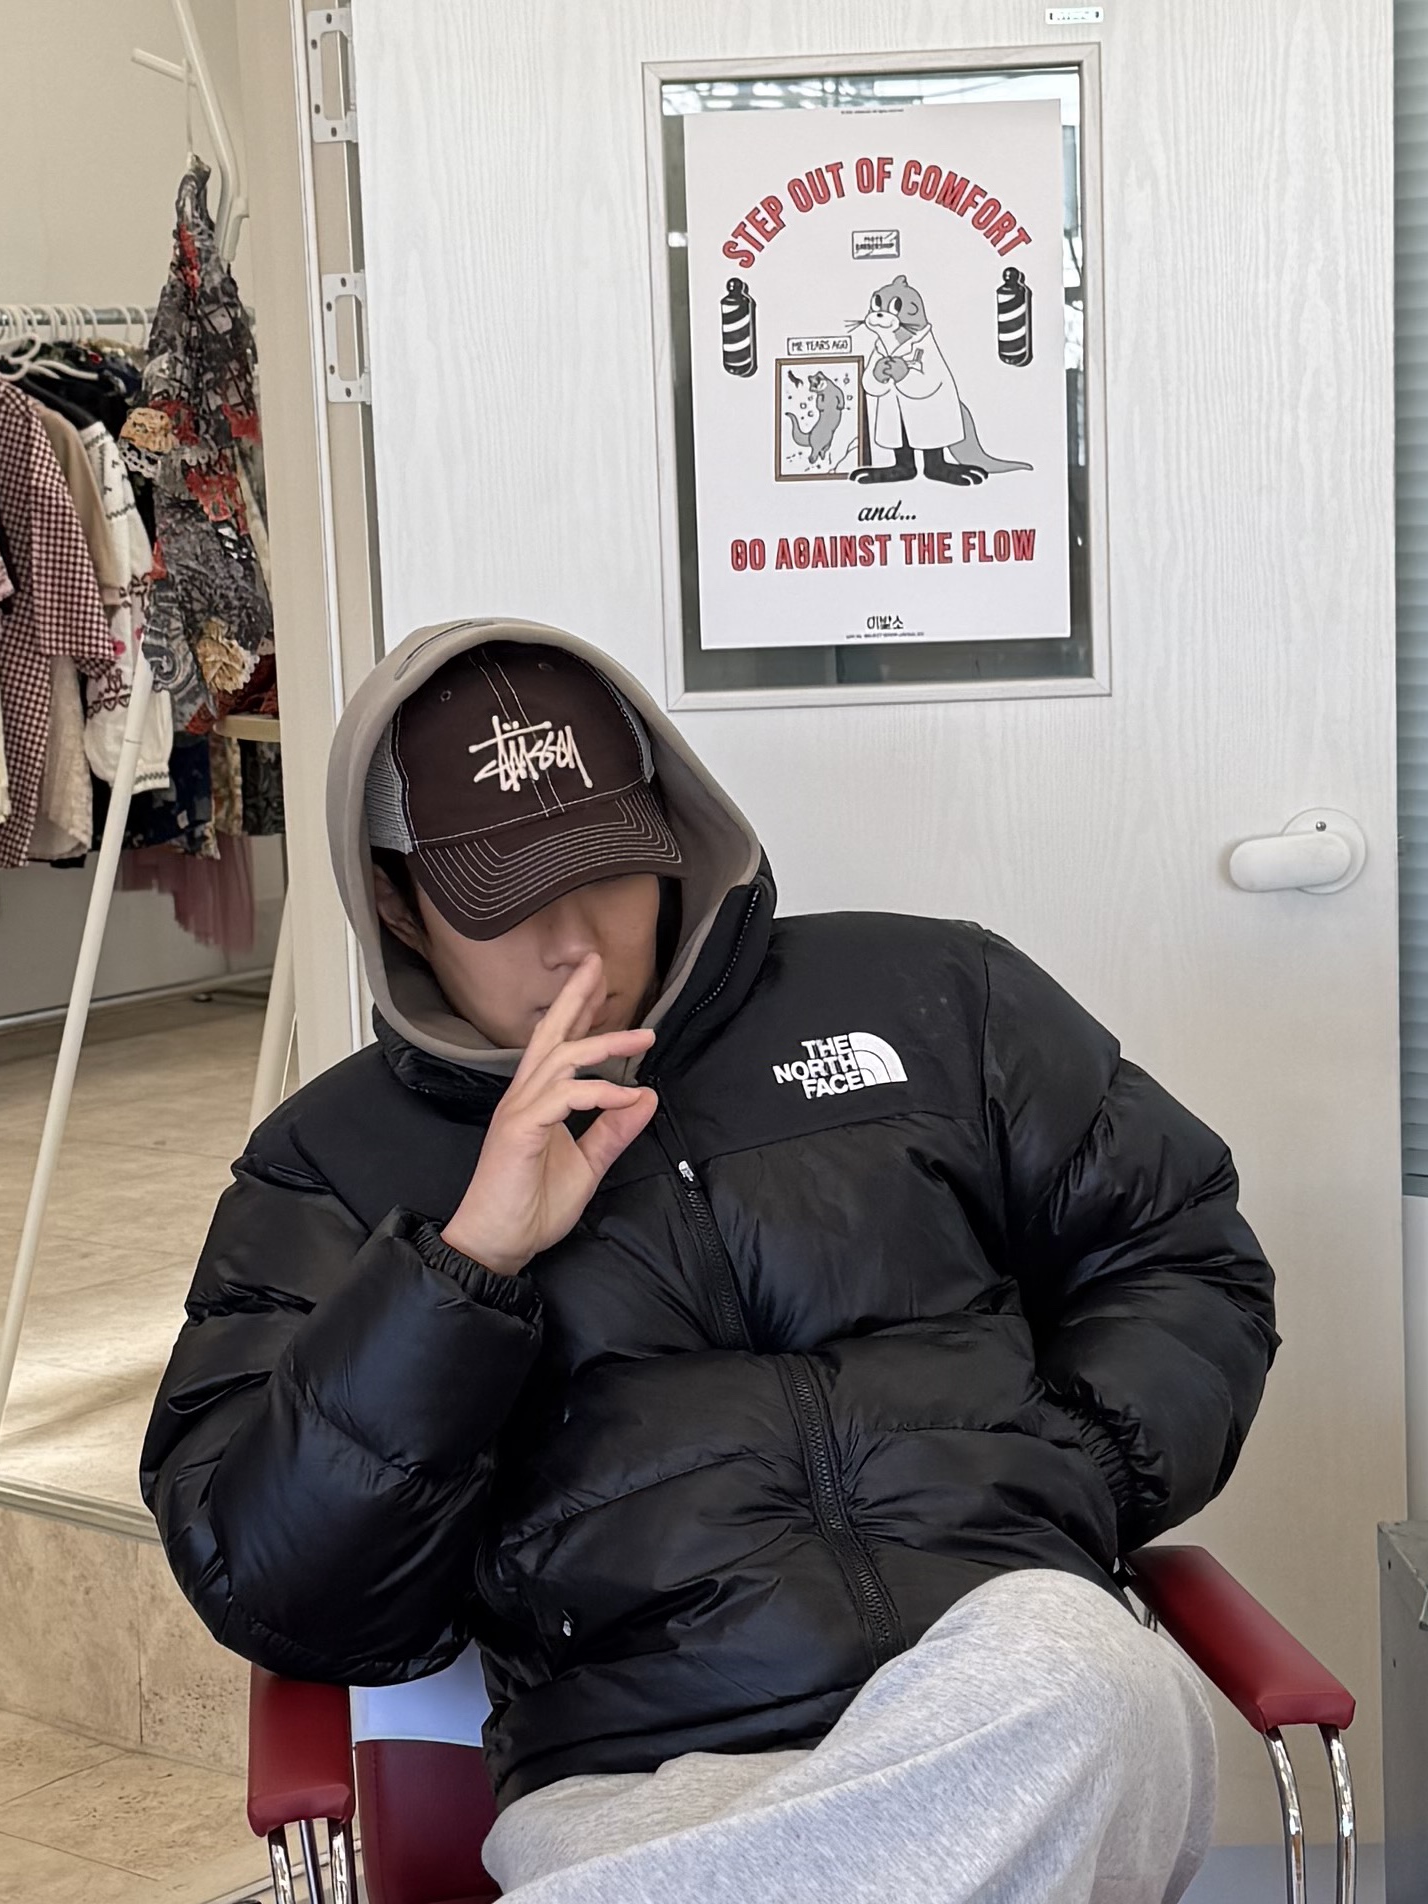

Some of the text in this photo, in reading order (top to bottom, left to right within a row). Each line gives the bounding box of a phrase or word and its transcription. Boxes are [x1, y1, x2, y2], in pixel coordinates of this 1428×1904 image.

[722, 157, 1032, 269] STEP OUT OF COMFORT
[858, 500, 917, 522] and...
[730, 528, 1036, 572] GO AGAINST THE FLOW
[866, 614, 904, 630] 이발소
[801, 1034, 852, 1059] THE
[772, 1051, 858, 1084] NORTH
[802, 1071, 865, 1099] FACE
